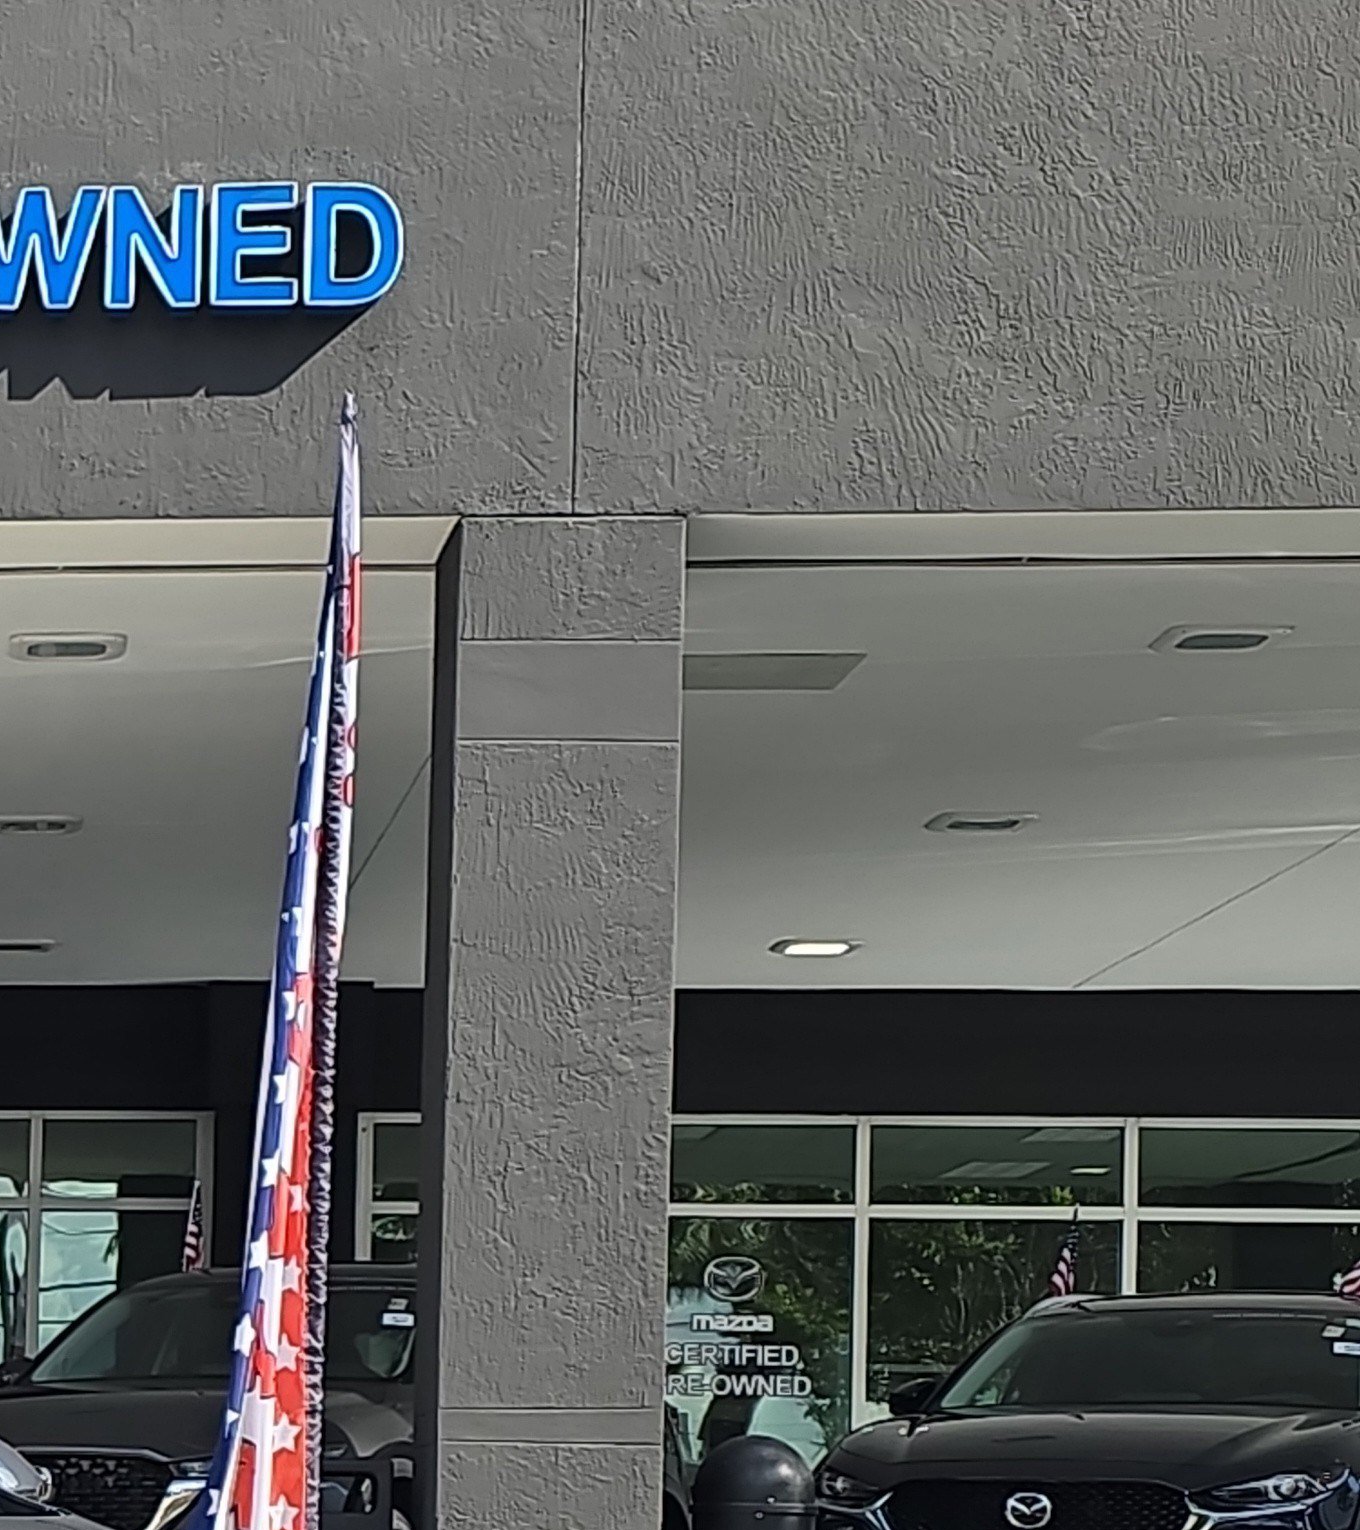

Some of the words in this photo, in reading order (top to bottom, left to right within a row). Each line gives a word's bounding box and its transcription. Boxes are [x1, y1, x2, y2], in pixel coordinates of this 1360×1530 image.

[692, 1315, 774, 1332] mazda
[665, 1343, 799, 1366] CERTIFIED
[666, 1374, 813, 1397] RE-OWNED
